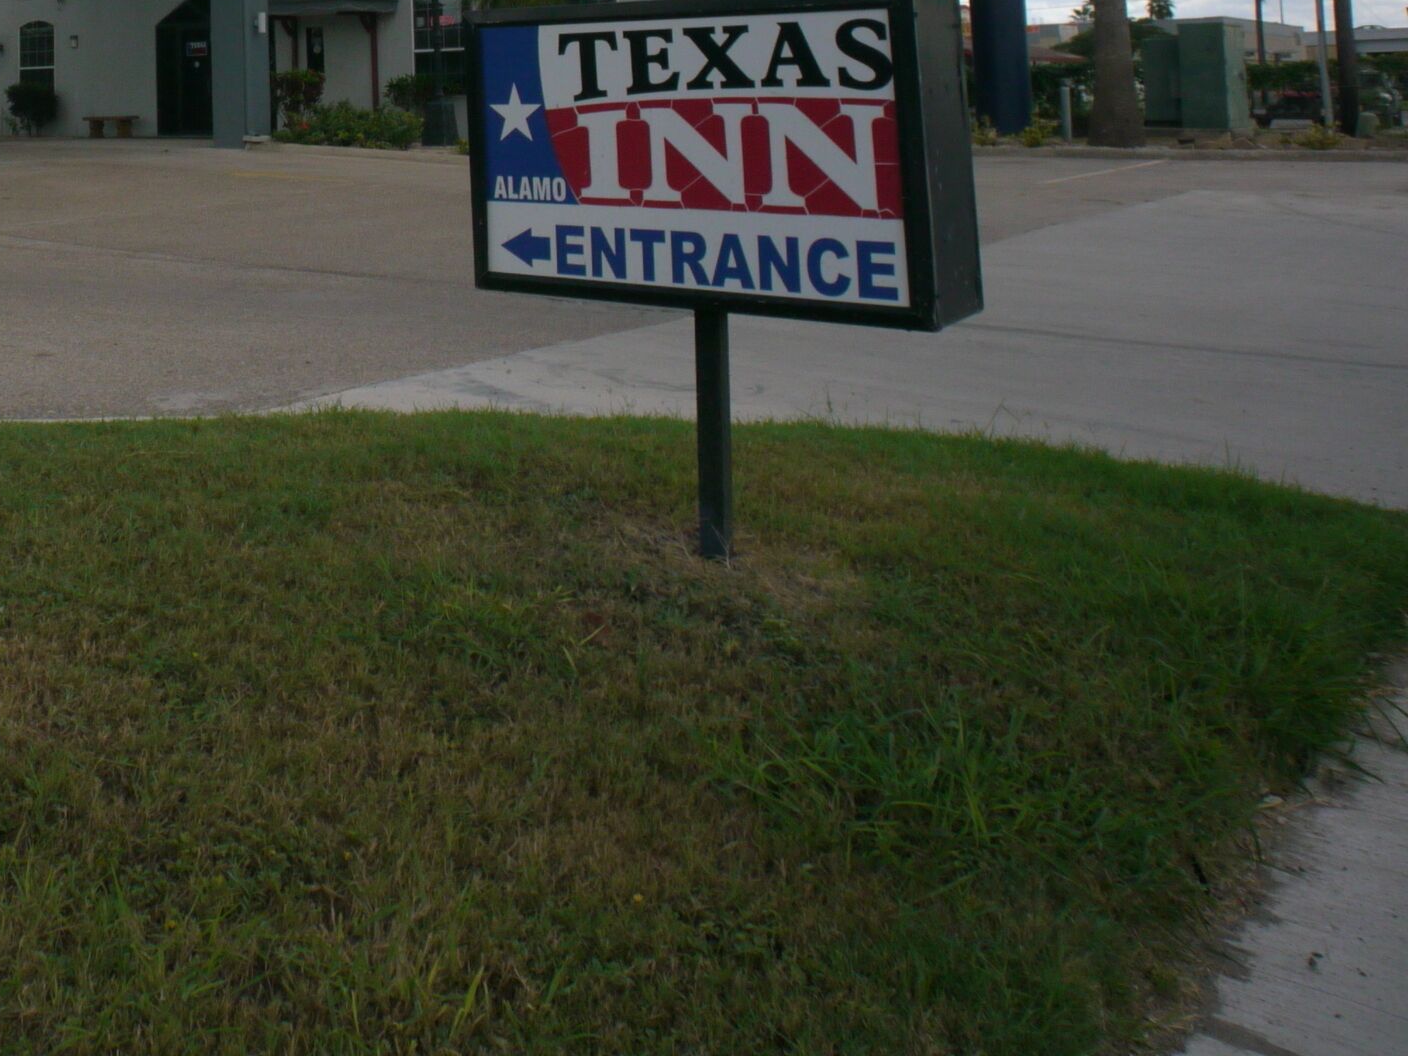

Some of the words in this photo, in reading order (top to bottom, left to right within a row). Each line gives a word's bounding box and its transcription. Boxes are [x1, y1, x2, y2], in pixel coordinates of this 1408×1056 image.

[558, 18, 892, 101] TEXAS
[494, 175, 566, 202] ALAMO
[577, 102, 884, 211] INN
[555, 225, 898, 301] ENTRANCE
